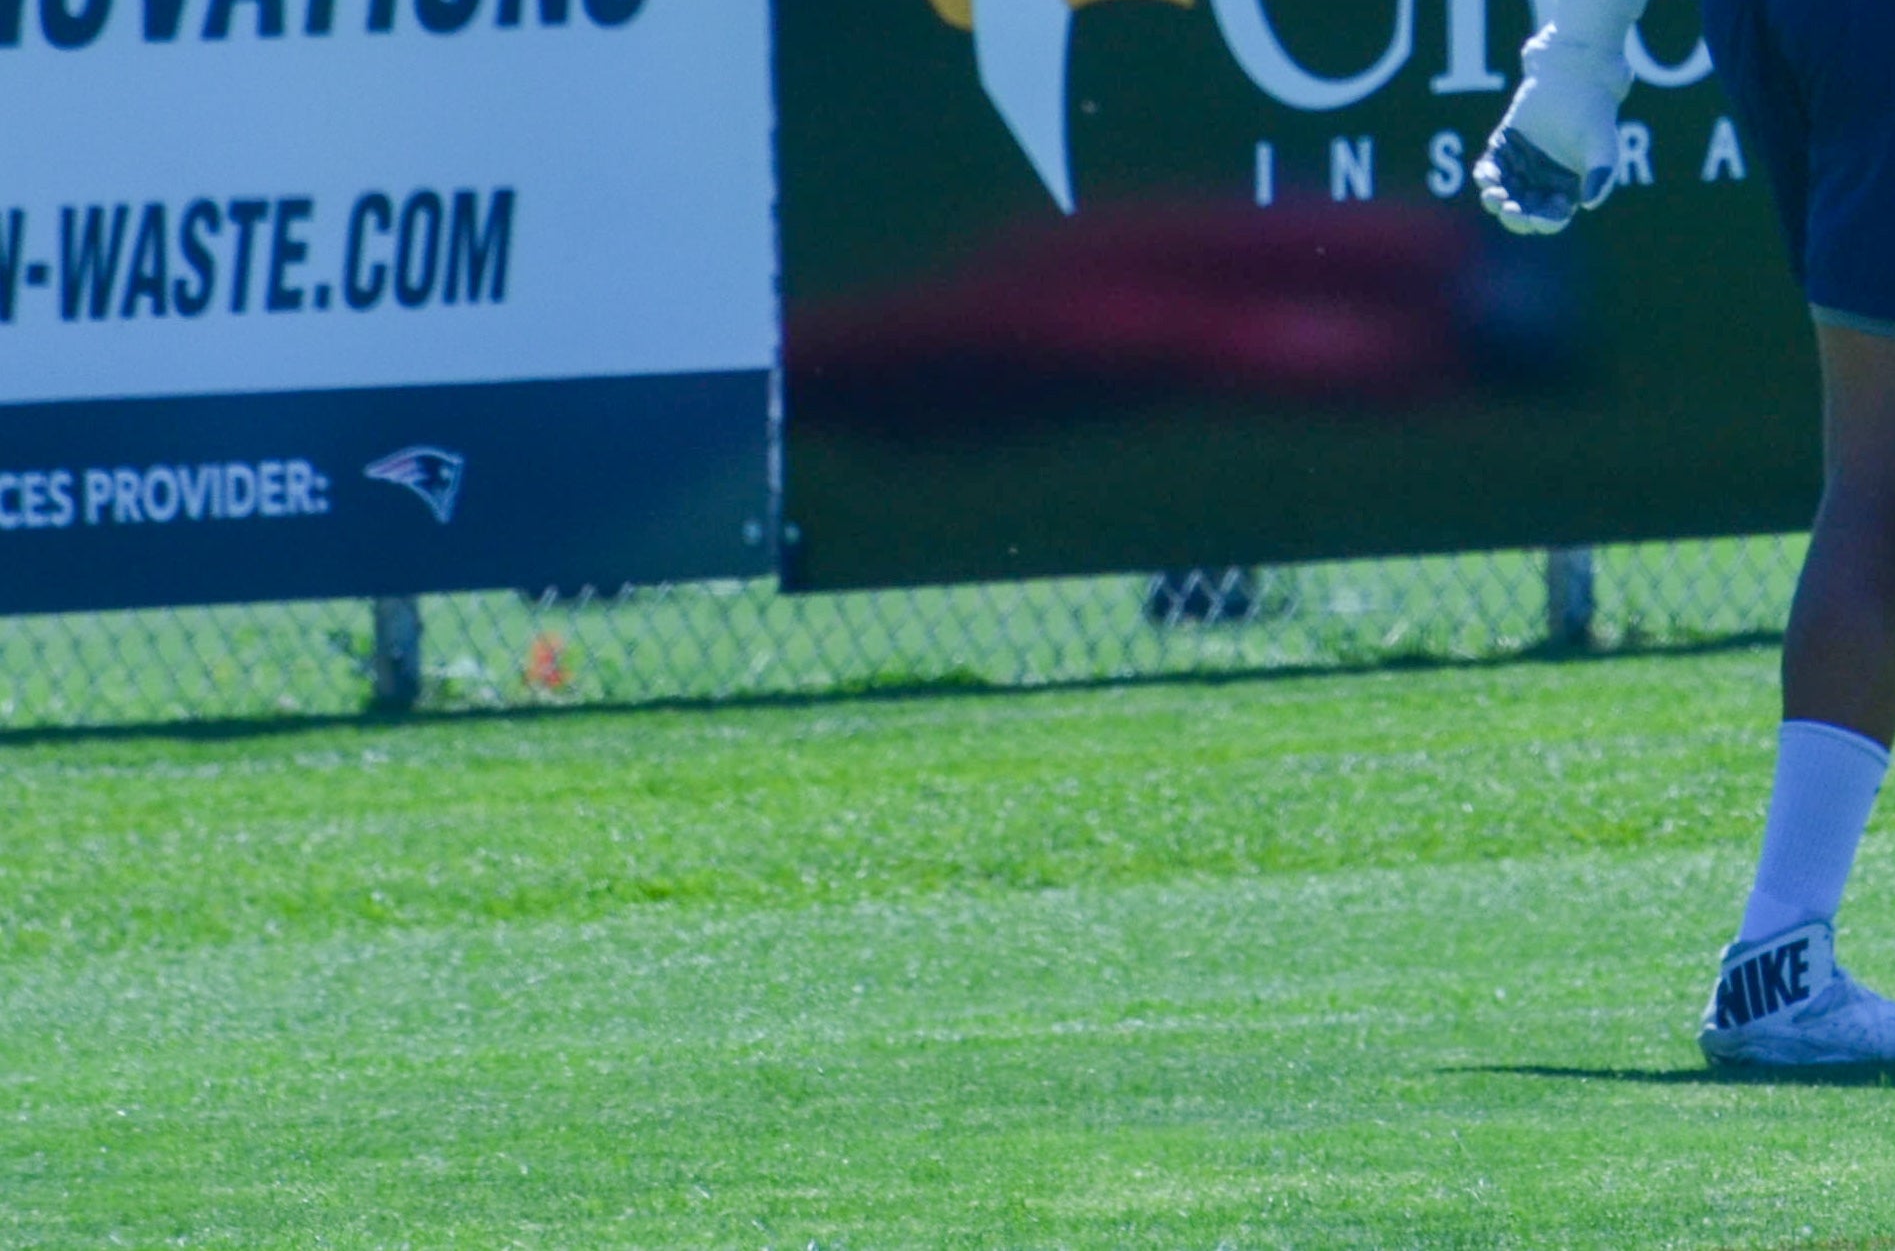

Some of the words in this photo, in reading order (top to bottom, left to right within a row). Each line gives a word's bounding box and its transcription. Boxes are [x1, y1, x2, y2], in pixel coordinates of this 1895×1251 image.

[1254, 116, 1747, 207] INSRA
[84, 459, 330, 524] PROVIDER:
[1716, 937, 1810, 1030] NIKE
